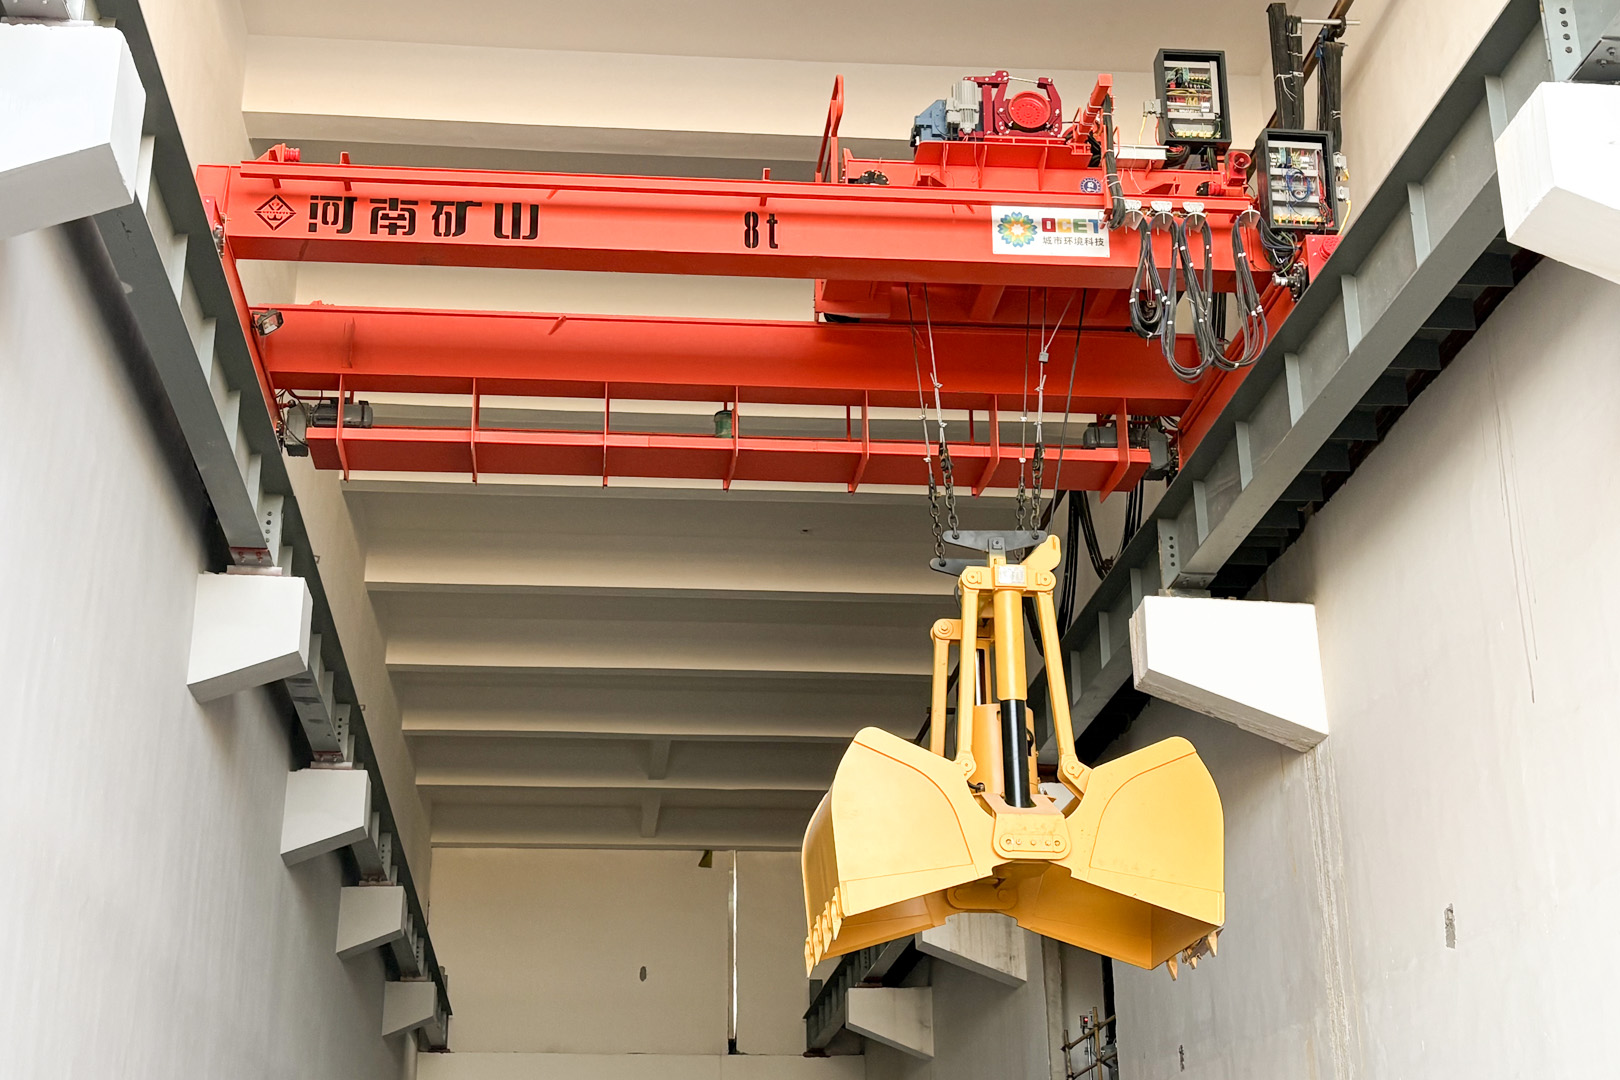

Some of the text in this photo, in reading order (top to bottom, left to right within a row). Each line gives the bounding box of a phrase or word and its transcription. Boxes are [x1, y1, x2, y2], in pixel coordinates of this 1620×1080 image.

[307, 194, 540, 241] 河南矿山
[743, 211, 779, 249] 8t
[1041, 217, 1100, 234] OCET
[1042, 236, 1105, 247] 城市环境科技
